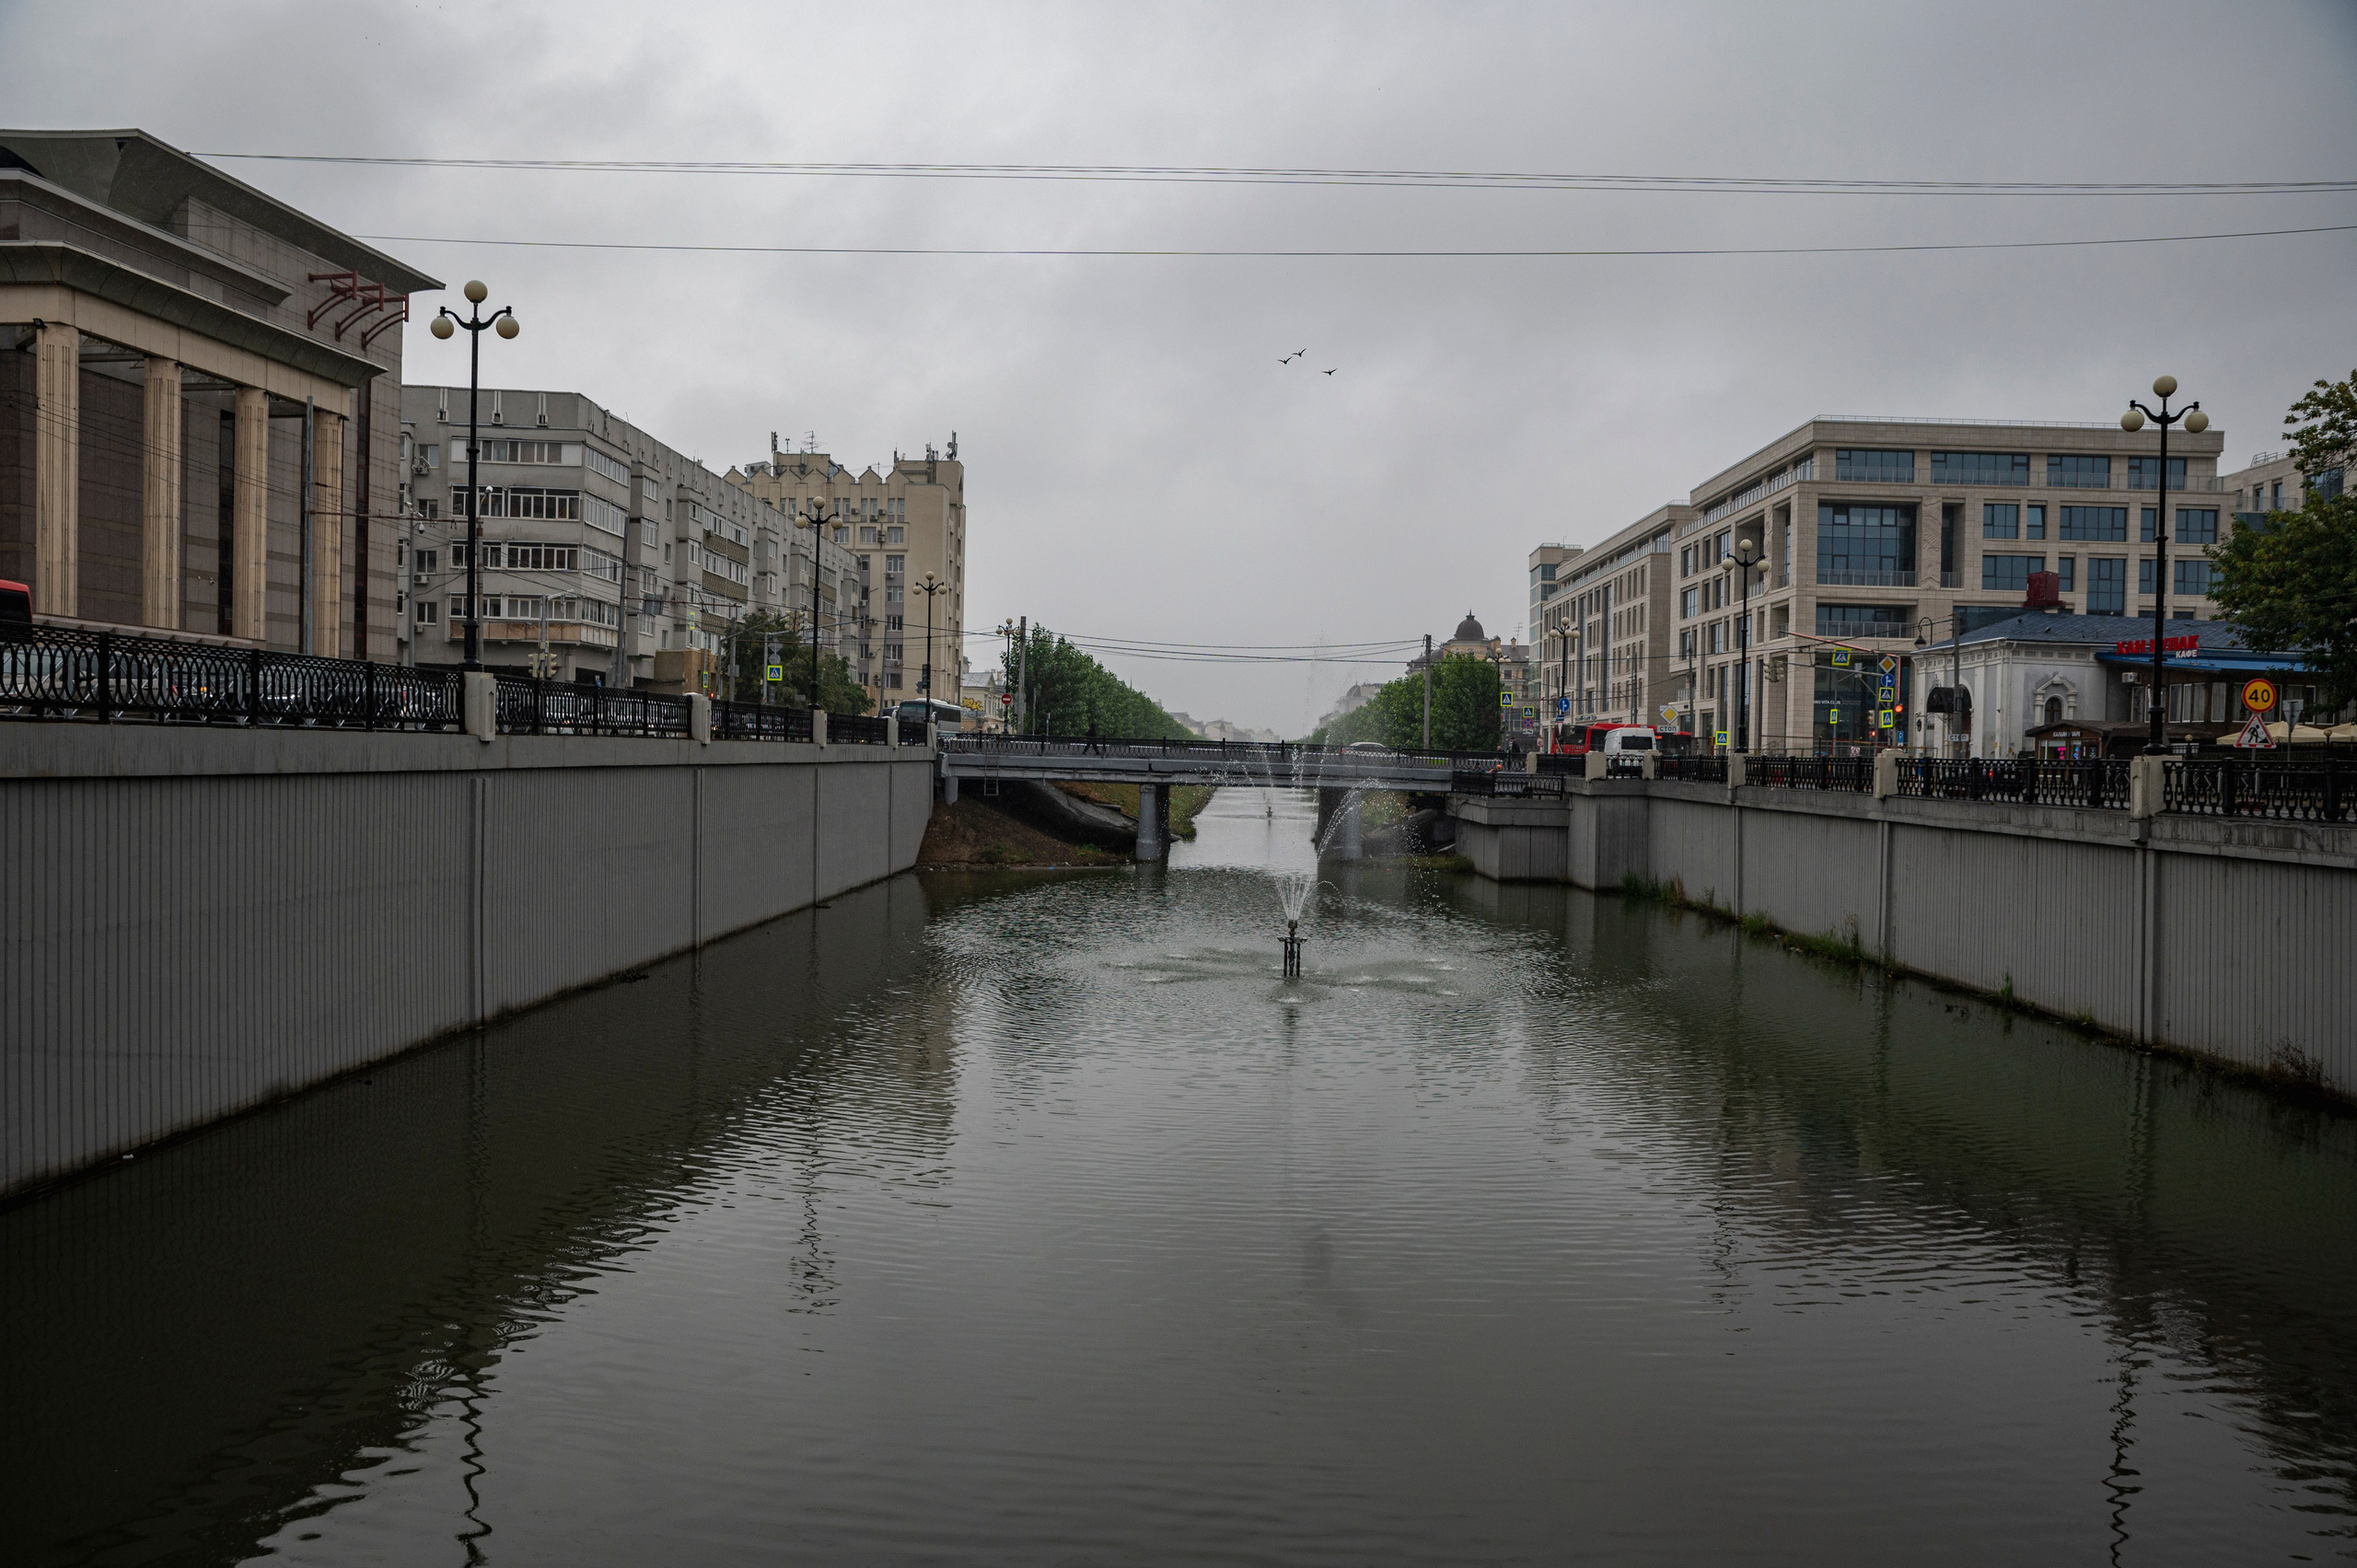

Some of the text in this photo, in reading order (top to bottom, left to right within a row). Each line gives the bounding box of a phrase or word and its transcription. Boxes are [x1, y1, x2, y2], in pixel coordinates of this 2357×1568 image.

[2115, 640, 2146, 656] ХАН
[2176, 649, 2198, 658] КАФЕ
[2248, 689, 2270, 703] 40
[1898, 732, 1904, 741] P
